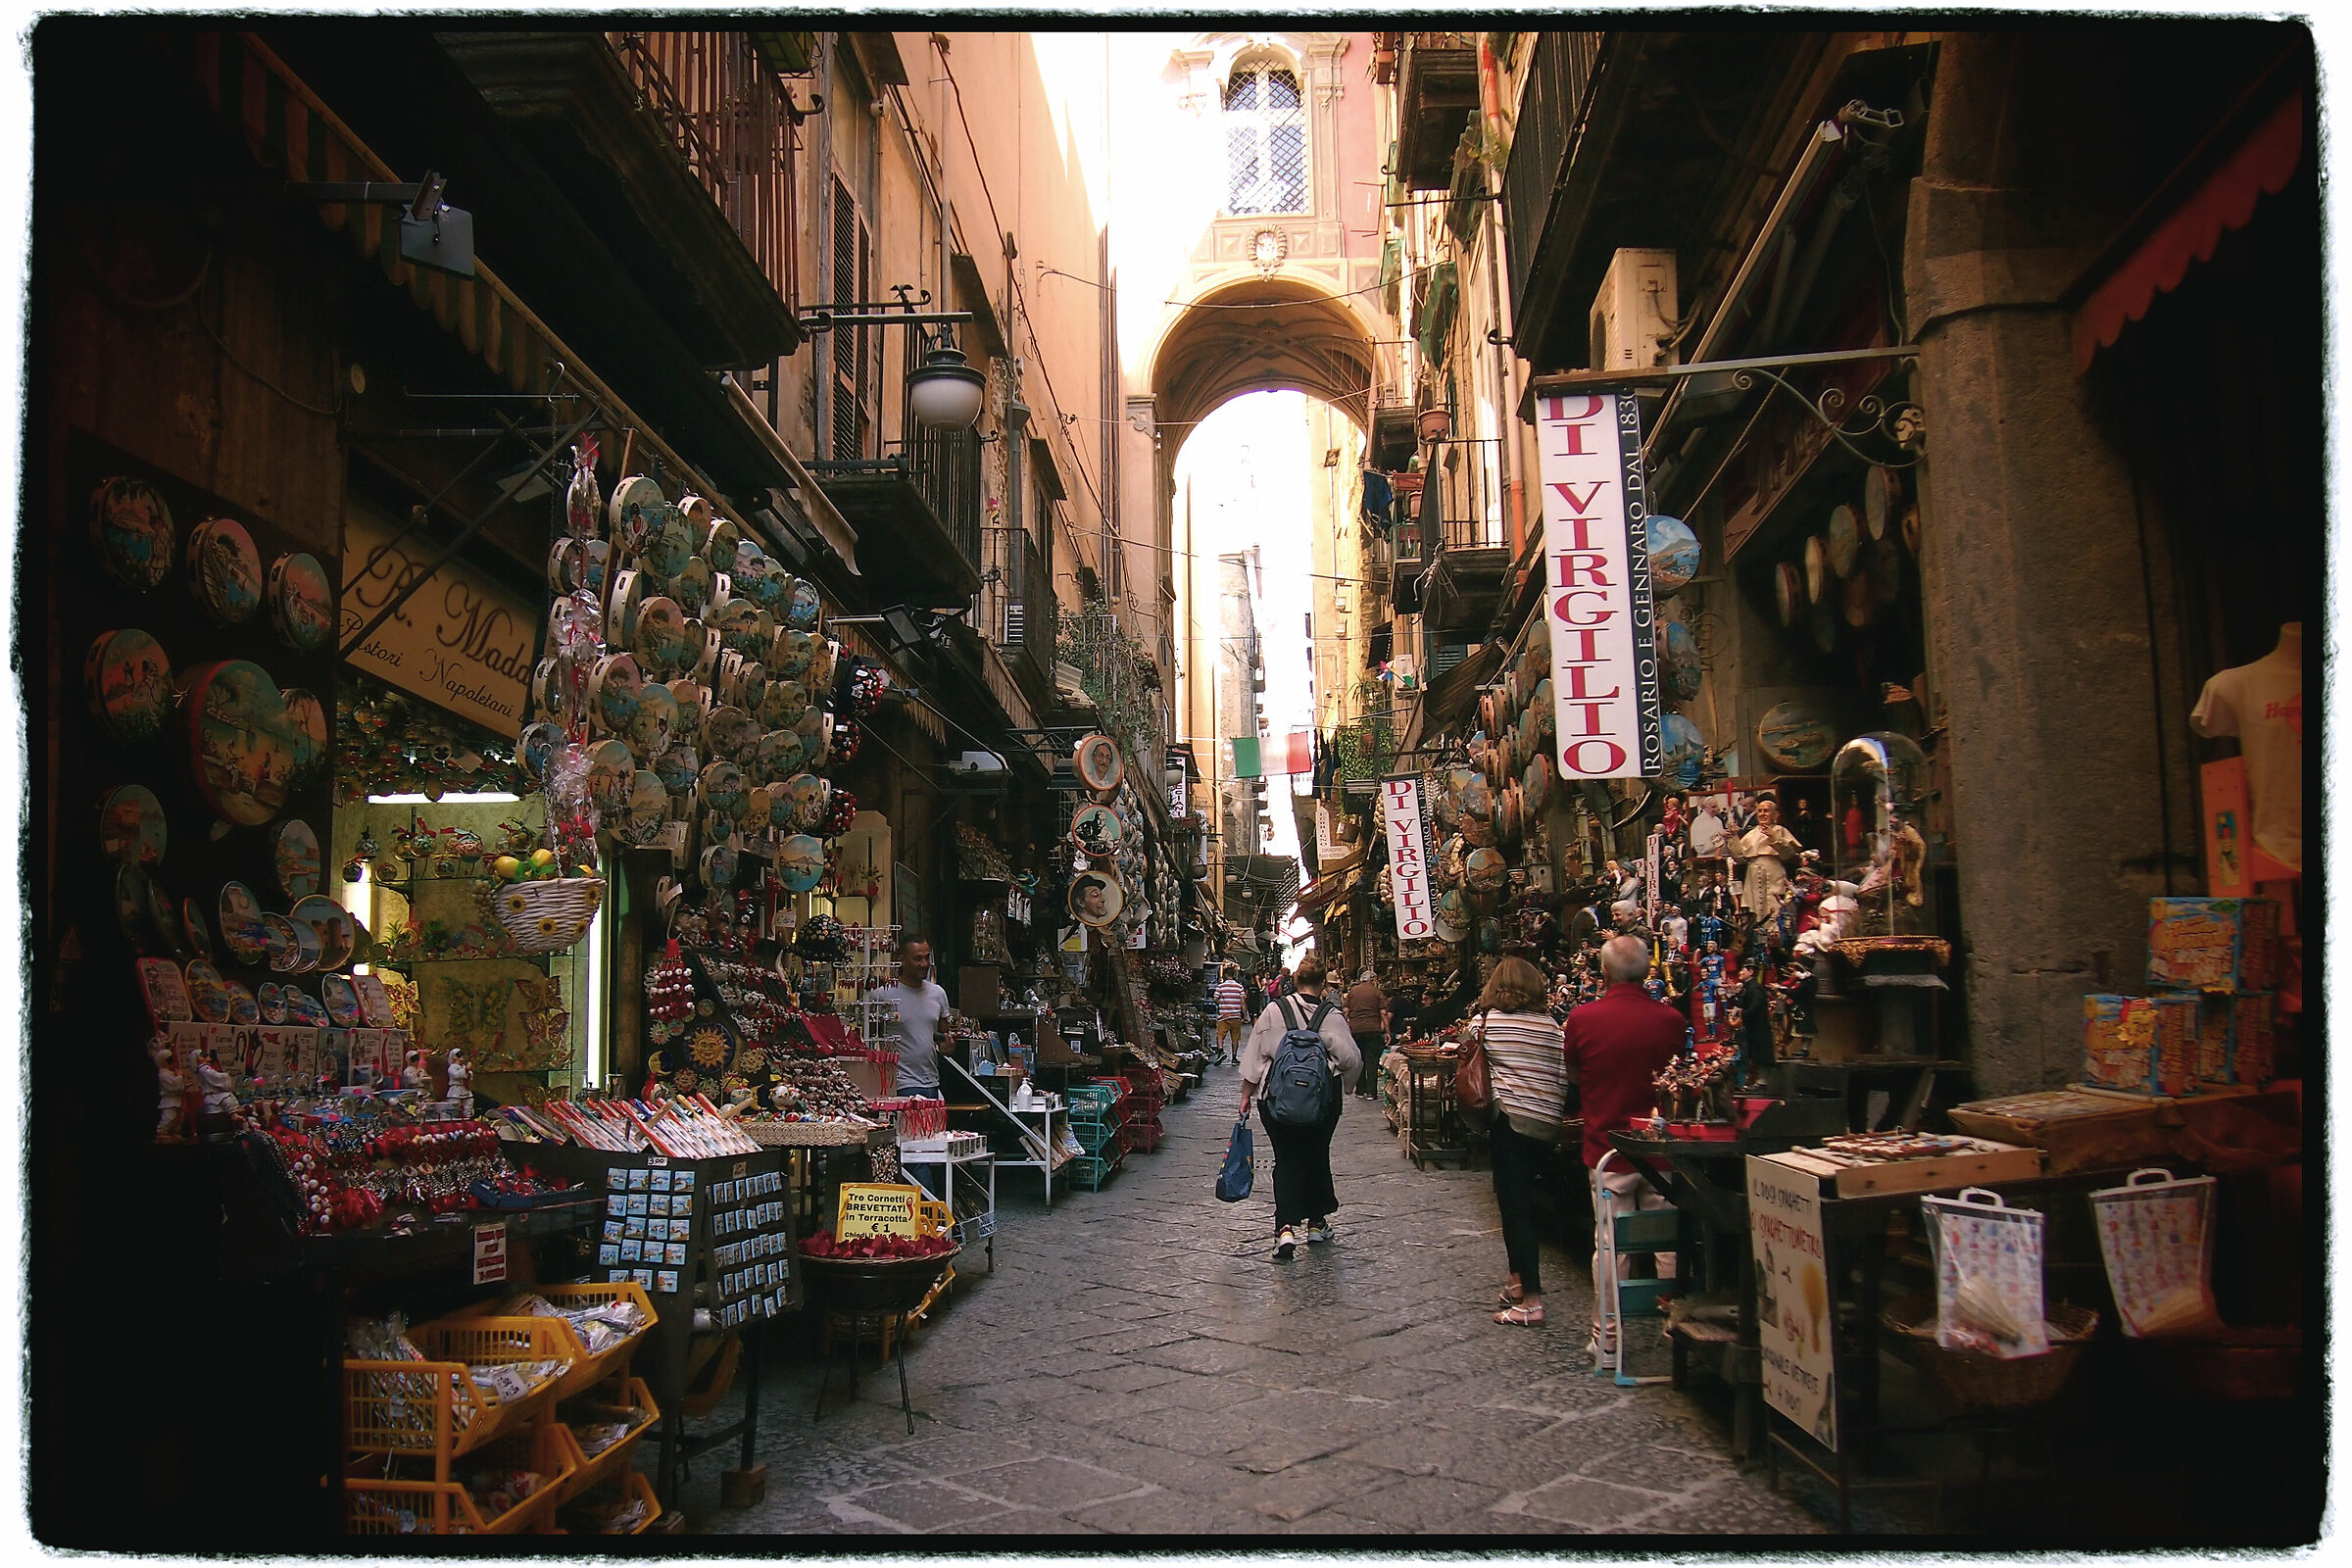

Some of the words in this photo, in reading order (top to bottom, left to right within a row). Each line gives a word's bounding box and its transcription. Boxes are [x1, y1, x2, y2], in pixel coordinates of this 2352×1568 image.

[1542, 394, 1604, 457] DI
[1625, 445, 1642, 491] DAL
[1629, 501, 1652, 628] GENNARO
[1544, 480, 1627, 775] VIRGILIO
[1638, 636, 1653, 649] E
[339, 608, 406, 668] Pstori
[418, 648, 514, 719] Napoletani
[1640, 659, 1661, 770] ROSARIO
[1387, 781, 1413, 810] DI
[1389, 817, 1429, 936] VIRGILIO
[846, 1202, 906, 1213] BREVETTATI
[848, 1193, 864, 1201] Tre
[867, 1194, 906, 1203] Cornetti
[858, 1213, 908, 1223] Terracotta
[870, 1222, 879, 1233] €
[883, 1223, 891, 1233] 1
